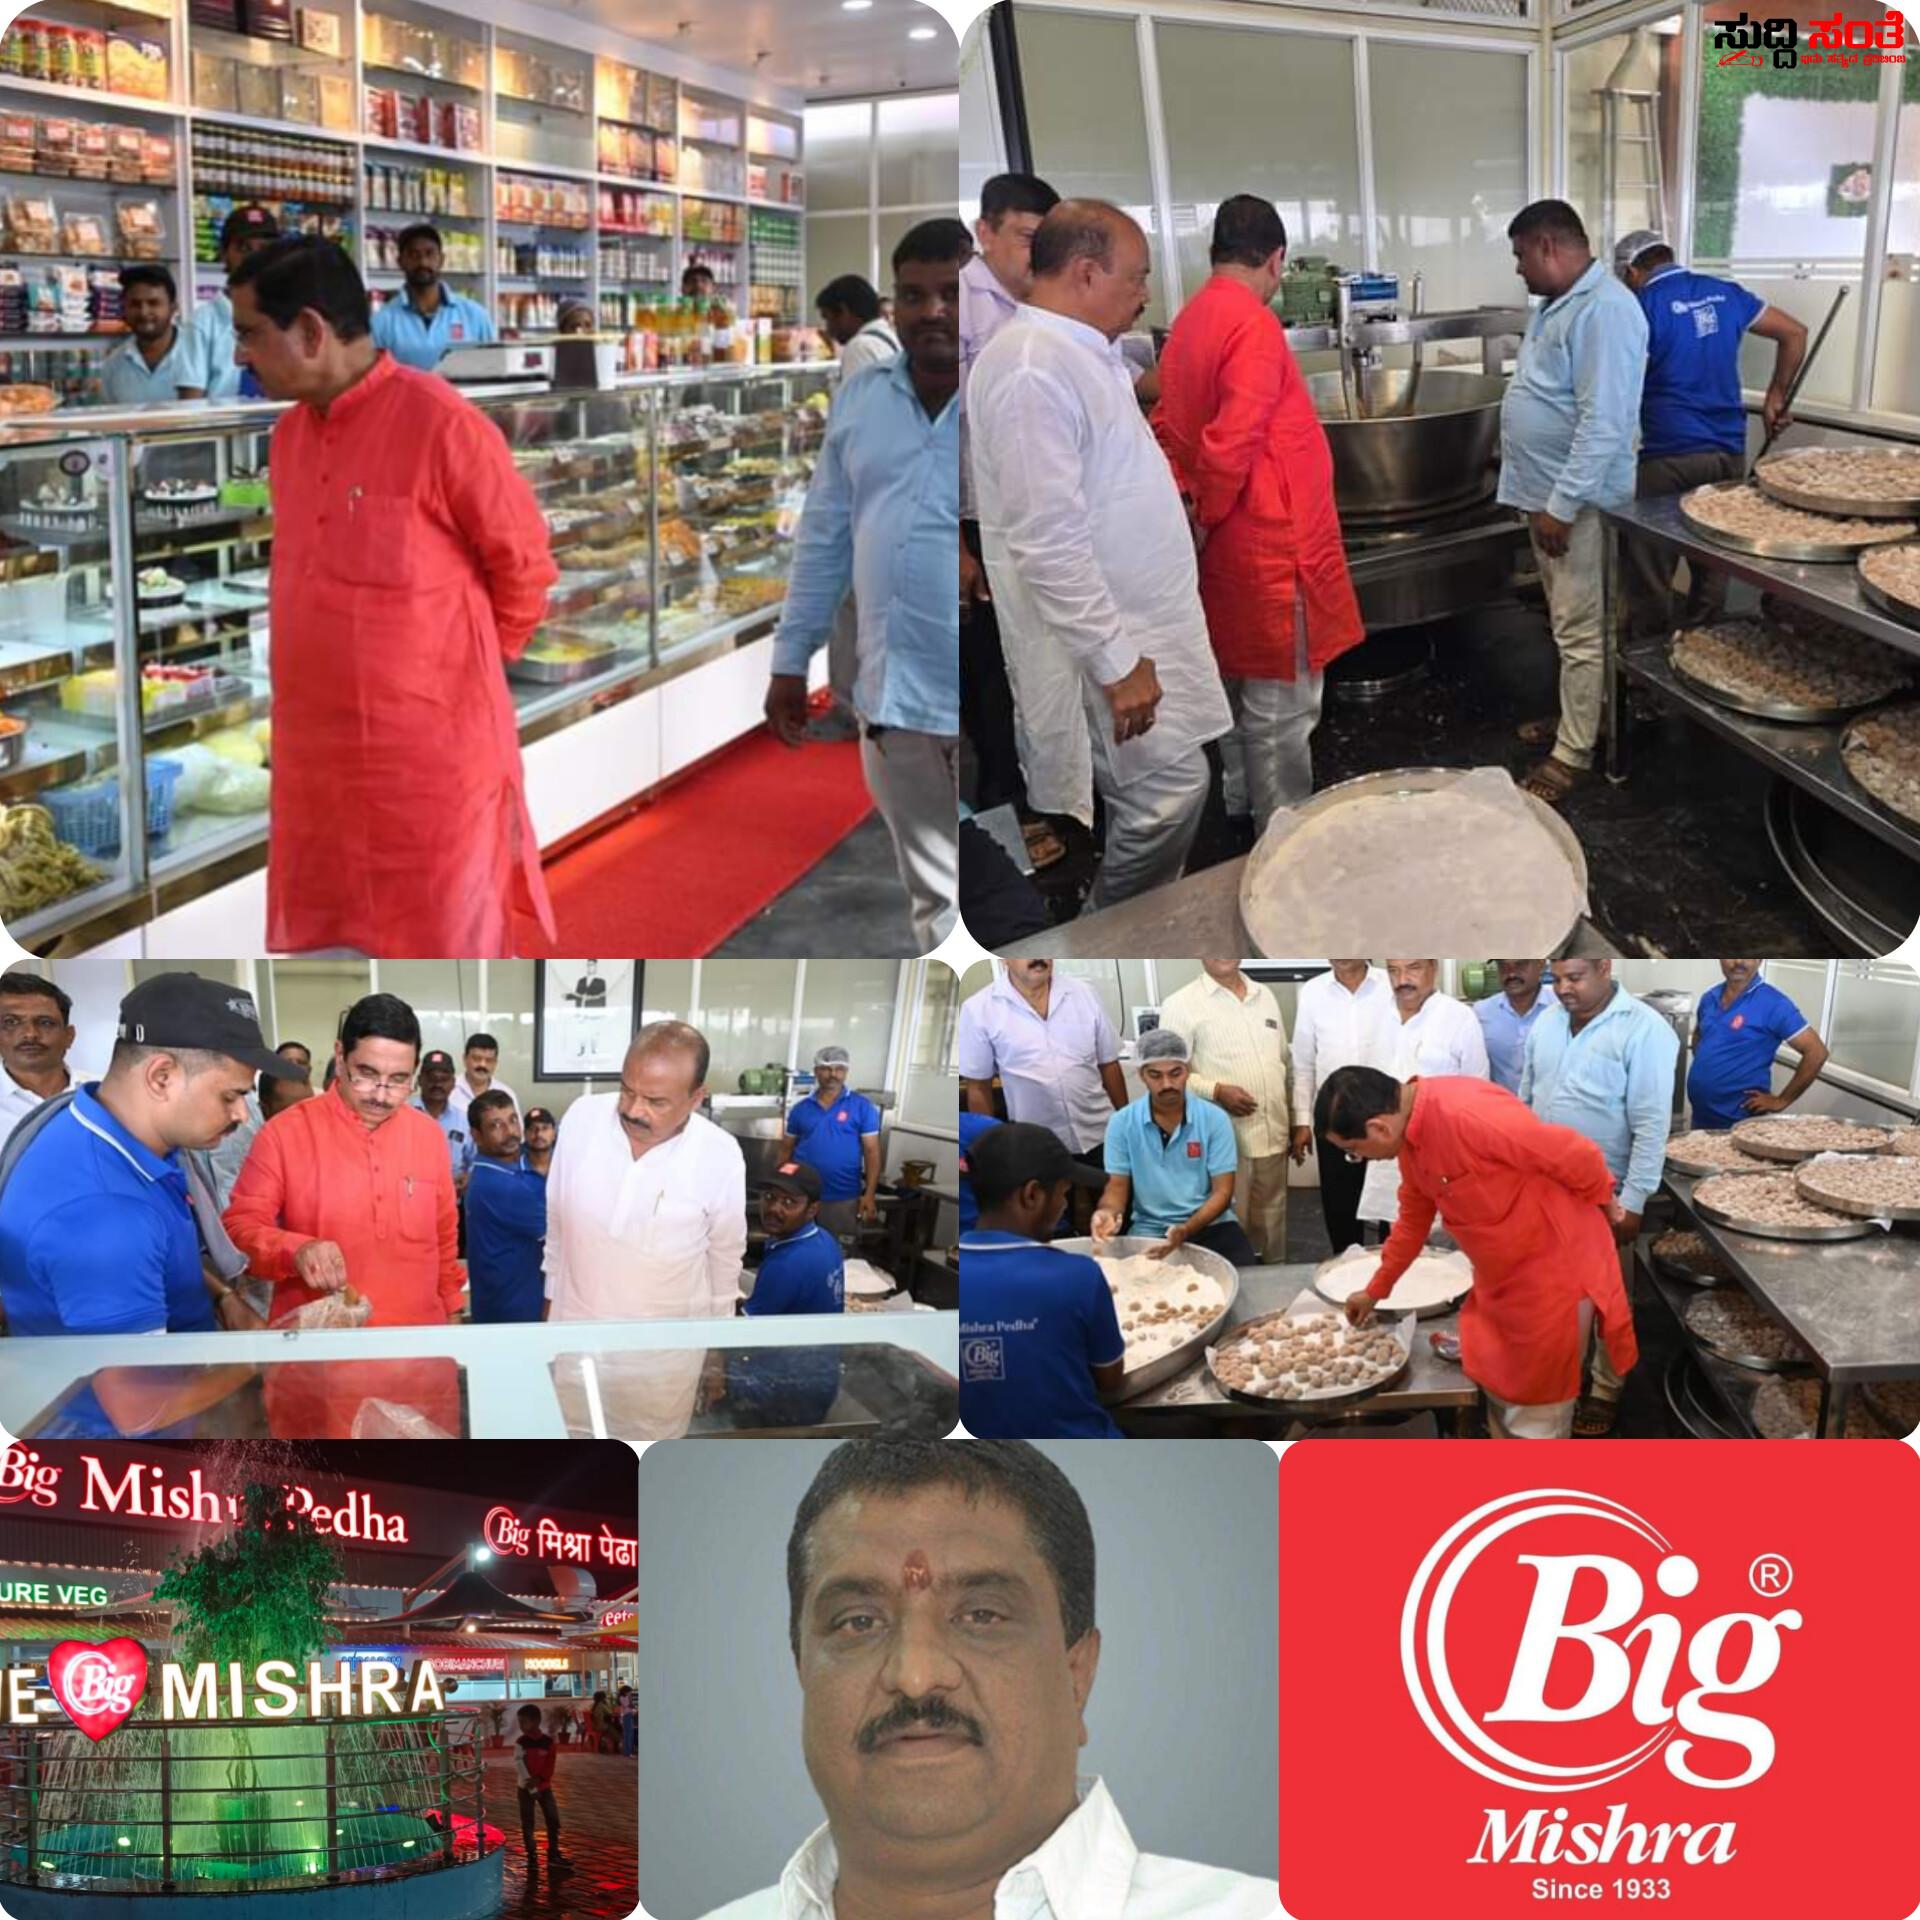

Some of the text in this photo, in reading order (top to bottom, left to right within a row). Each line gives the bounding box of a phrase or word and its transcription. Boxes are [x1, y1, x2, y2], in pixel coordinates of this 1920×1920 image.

[0, 1448, 62, 1506] Big
[80, 1456, 271, 1528] Mishr
[496, 1516, 531, 1556] Big
[536, 1518, 638, 1566] मिश्रा पेढा
[57, 1585, 107, 1606] VEG
[79, 1663, 136, 1714] Big
[162, 1660, 444, 1719] MISHRA
[1483, 1554, 1803, 1789] Big
[1466, 1803, 1737, 1865] Mishra
[1532, 1878, 1671, 1899] Since 1933
